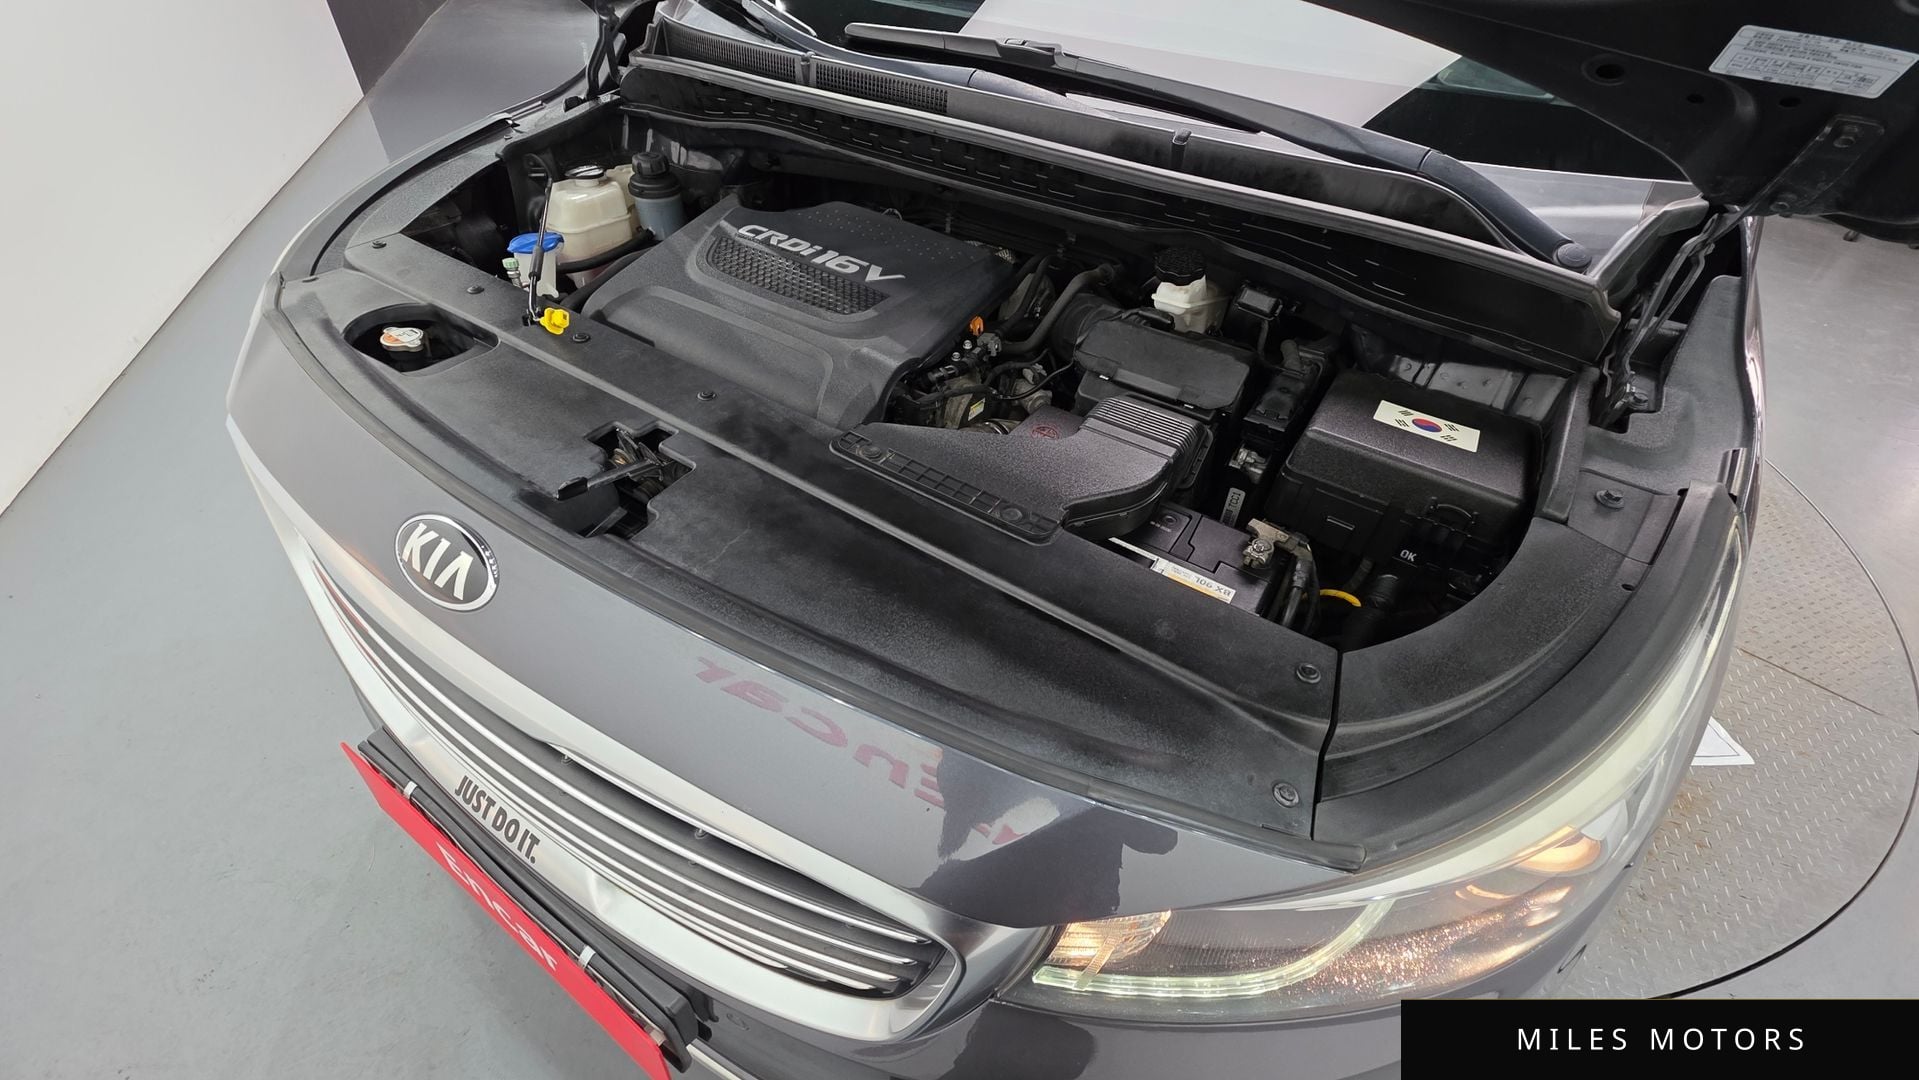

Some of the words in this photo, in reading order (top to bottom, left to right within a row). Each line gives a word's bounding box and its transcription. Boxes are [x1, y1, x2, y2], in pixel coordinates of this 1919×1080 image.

[738, 224, 823, 256] CRDi
[401, 522, 474, 601] KIA
[1399, 549, 1417, 562] OK
[454, 775, 496, 820] JUST
[491, 806, 520, 843] DO
[517, 828, 541, 865] IT.
